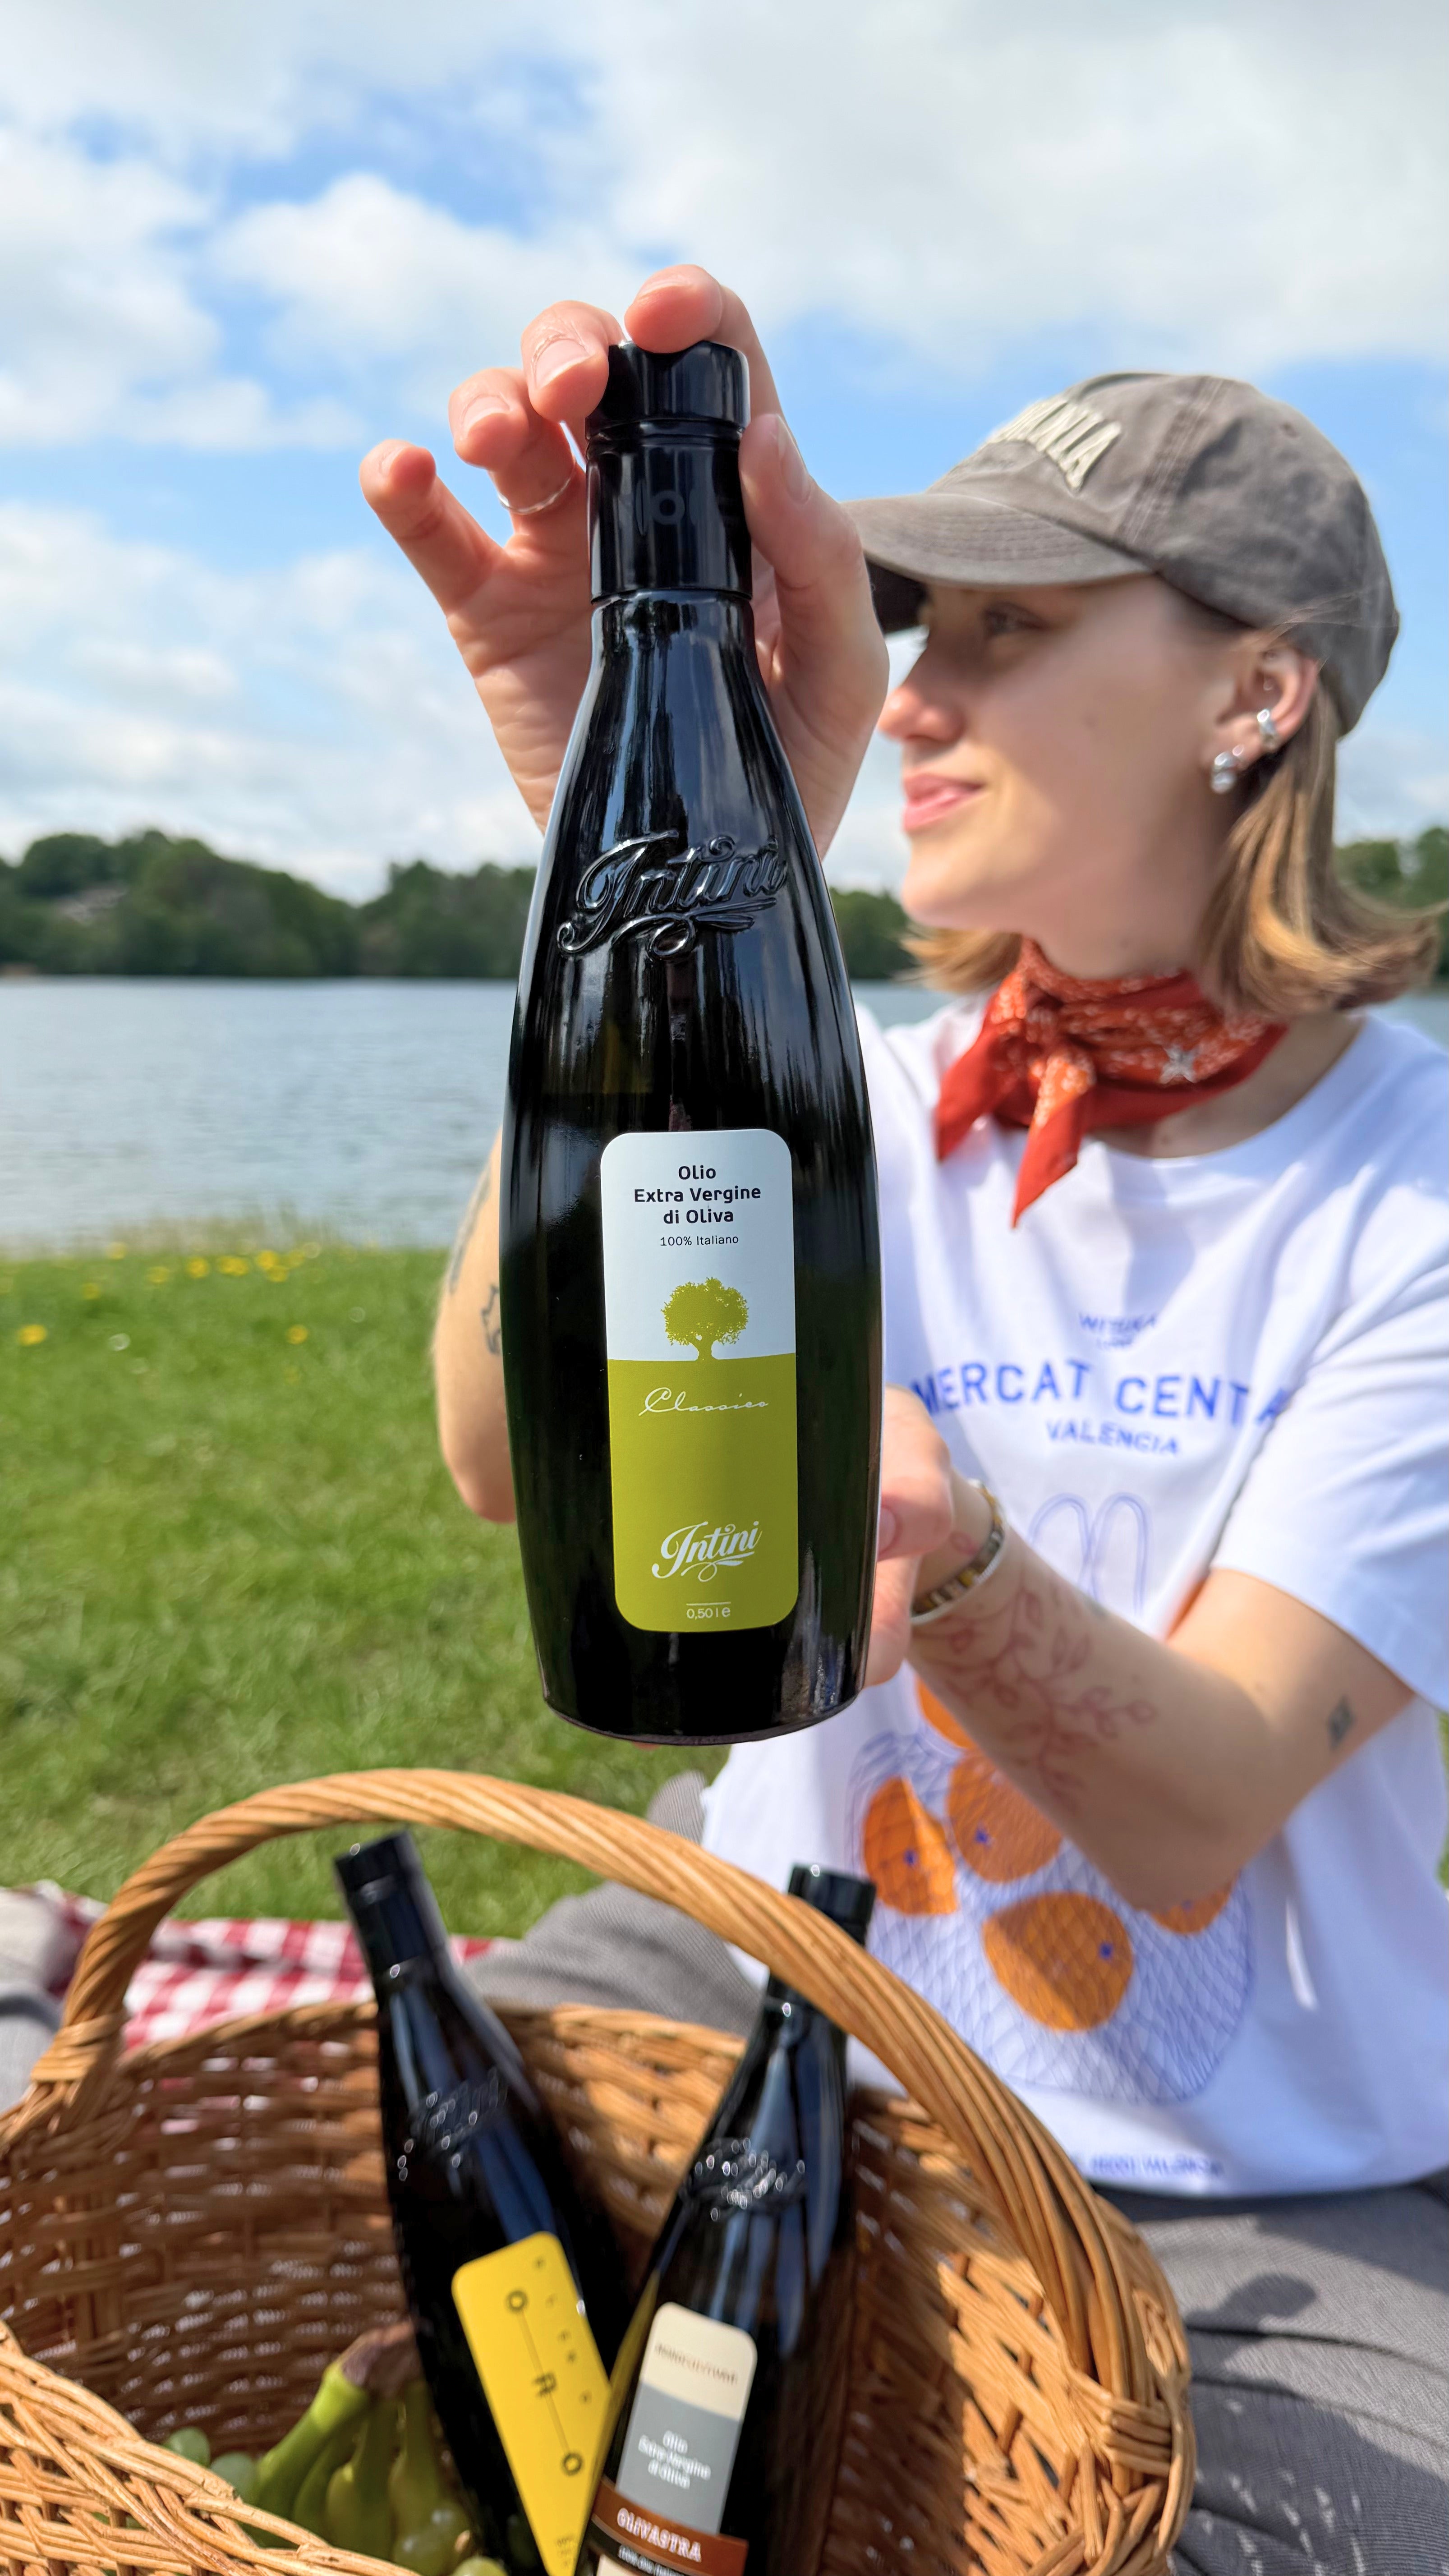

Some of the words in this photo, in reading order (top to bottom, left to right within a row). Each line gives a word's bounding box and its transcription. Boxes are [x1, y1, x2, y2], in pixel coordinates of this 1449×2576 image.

[557, 830, 788, 957] Intini
[678, 1165, 716, 1180] Olio
[634, 1189, 684, 1203] Extra
[690, 1185, 761, 1204] Vergine
[663, 1210, 679, 1224] di
[686, 1209, 734, 1224] Oliva
[660, 1236, 692, 1246] 100%
[697, 1235, 739, 1245] Italiano
[910, 1357, 1093, 1415] MERCAT
[638, 1387, 769, 1416] Classico
[1046, 1419, 1179, 1454] VALENCIA
[651, 1520, 763, 1582] Intini
